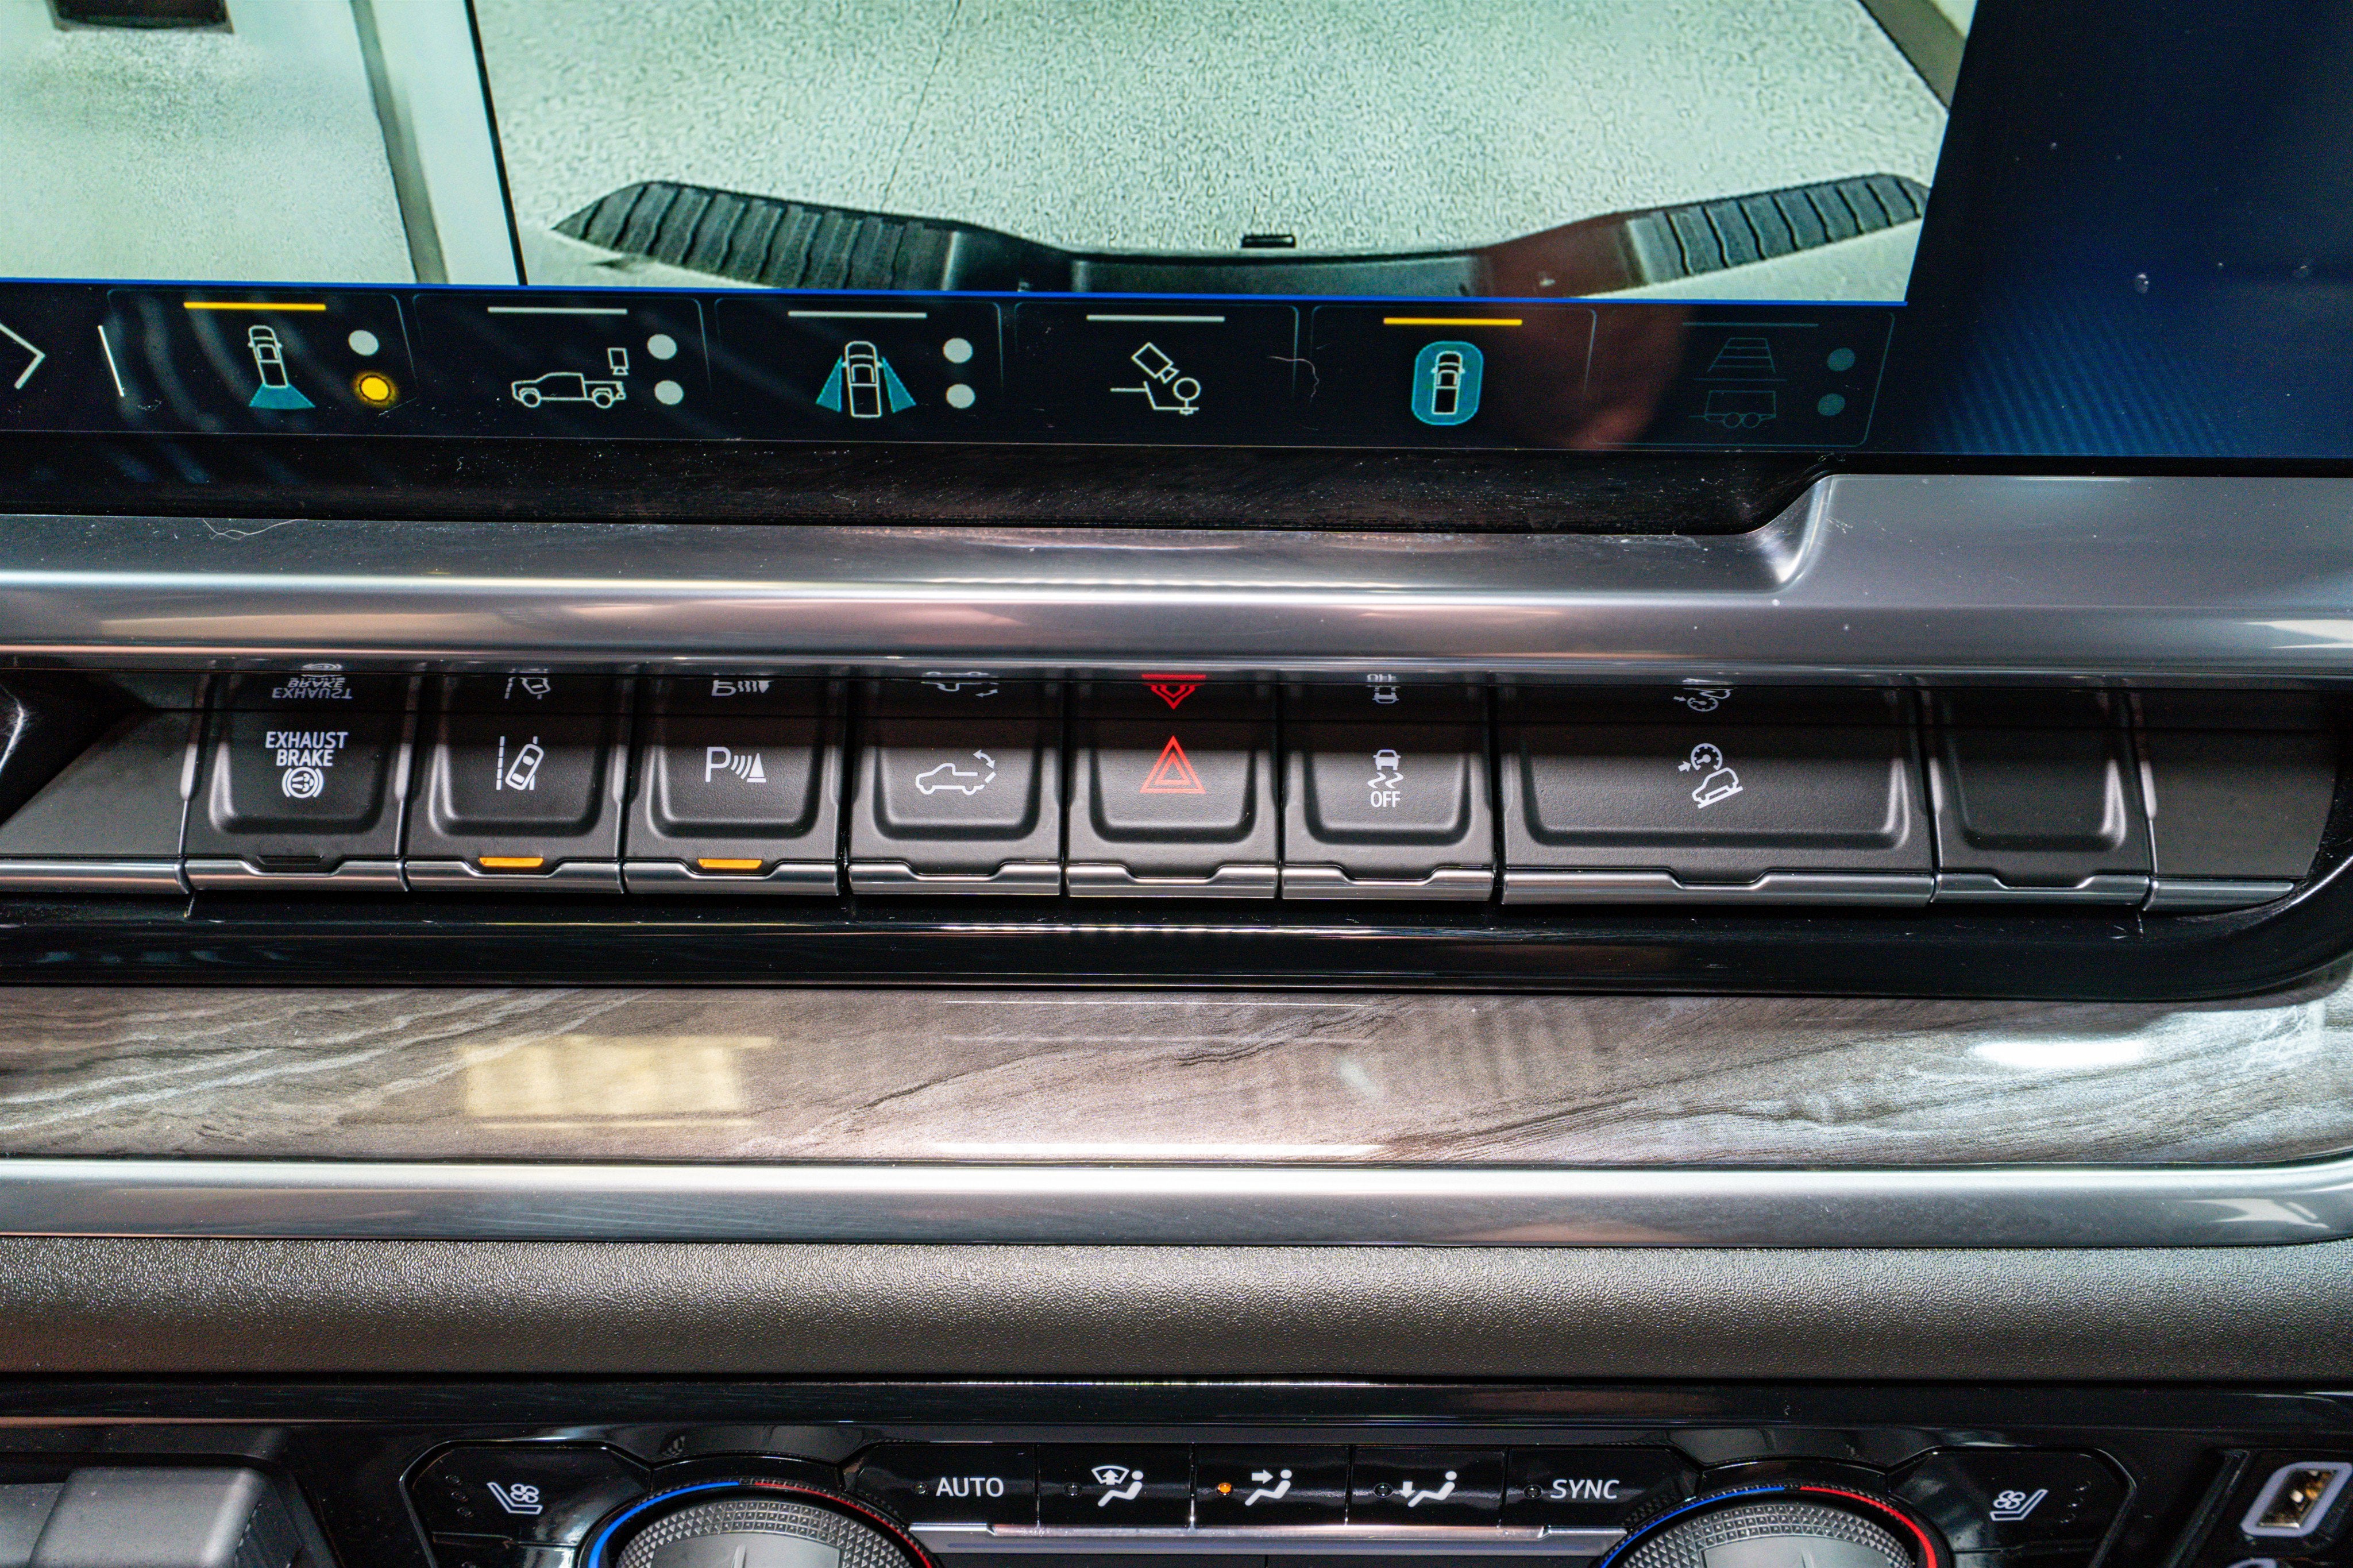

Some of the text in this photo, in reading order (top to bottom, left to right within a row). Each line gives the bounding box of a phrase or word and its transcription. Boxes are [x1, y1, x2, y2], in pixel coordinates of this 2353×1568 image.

[265, 731, 349, 749] EXHAUST
[276, 749, 334, 767] BRAKE
[705, 746, 731, 782] P
[1370, 790, 1401, 808] OFF
[935, 1477, 1004, 1497] AUTO
[1550, 1479, 1620, 1499] SYNC
